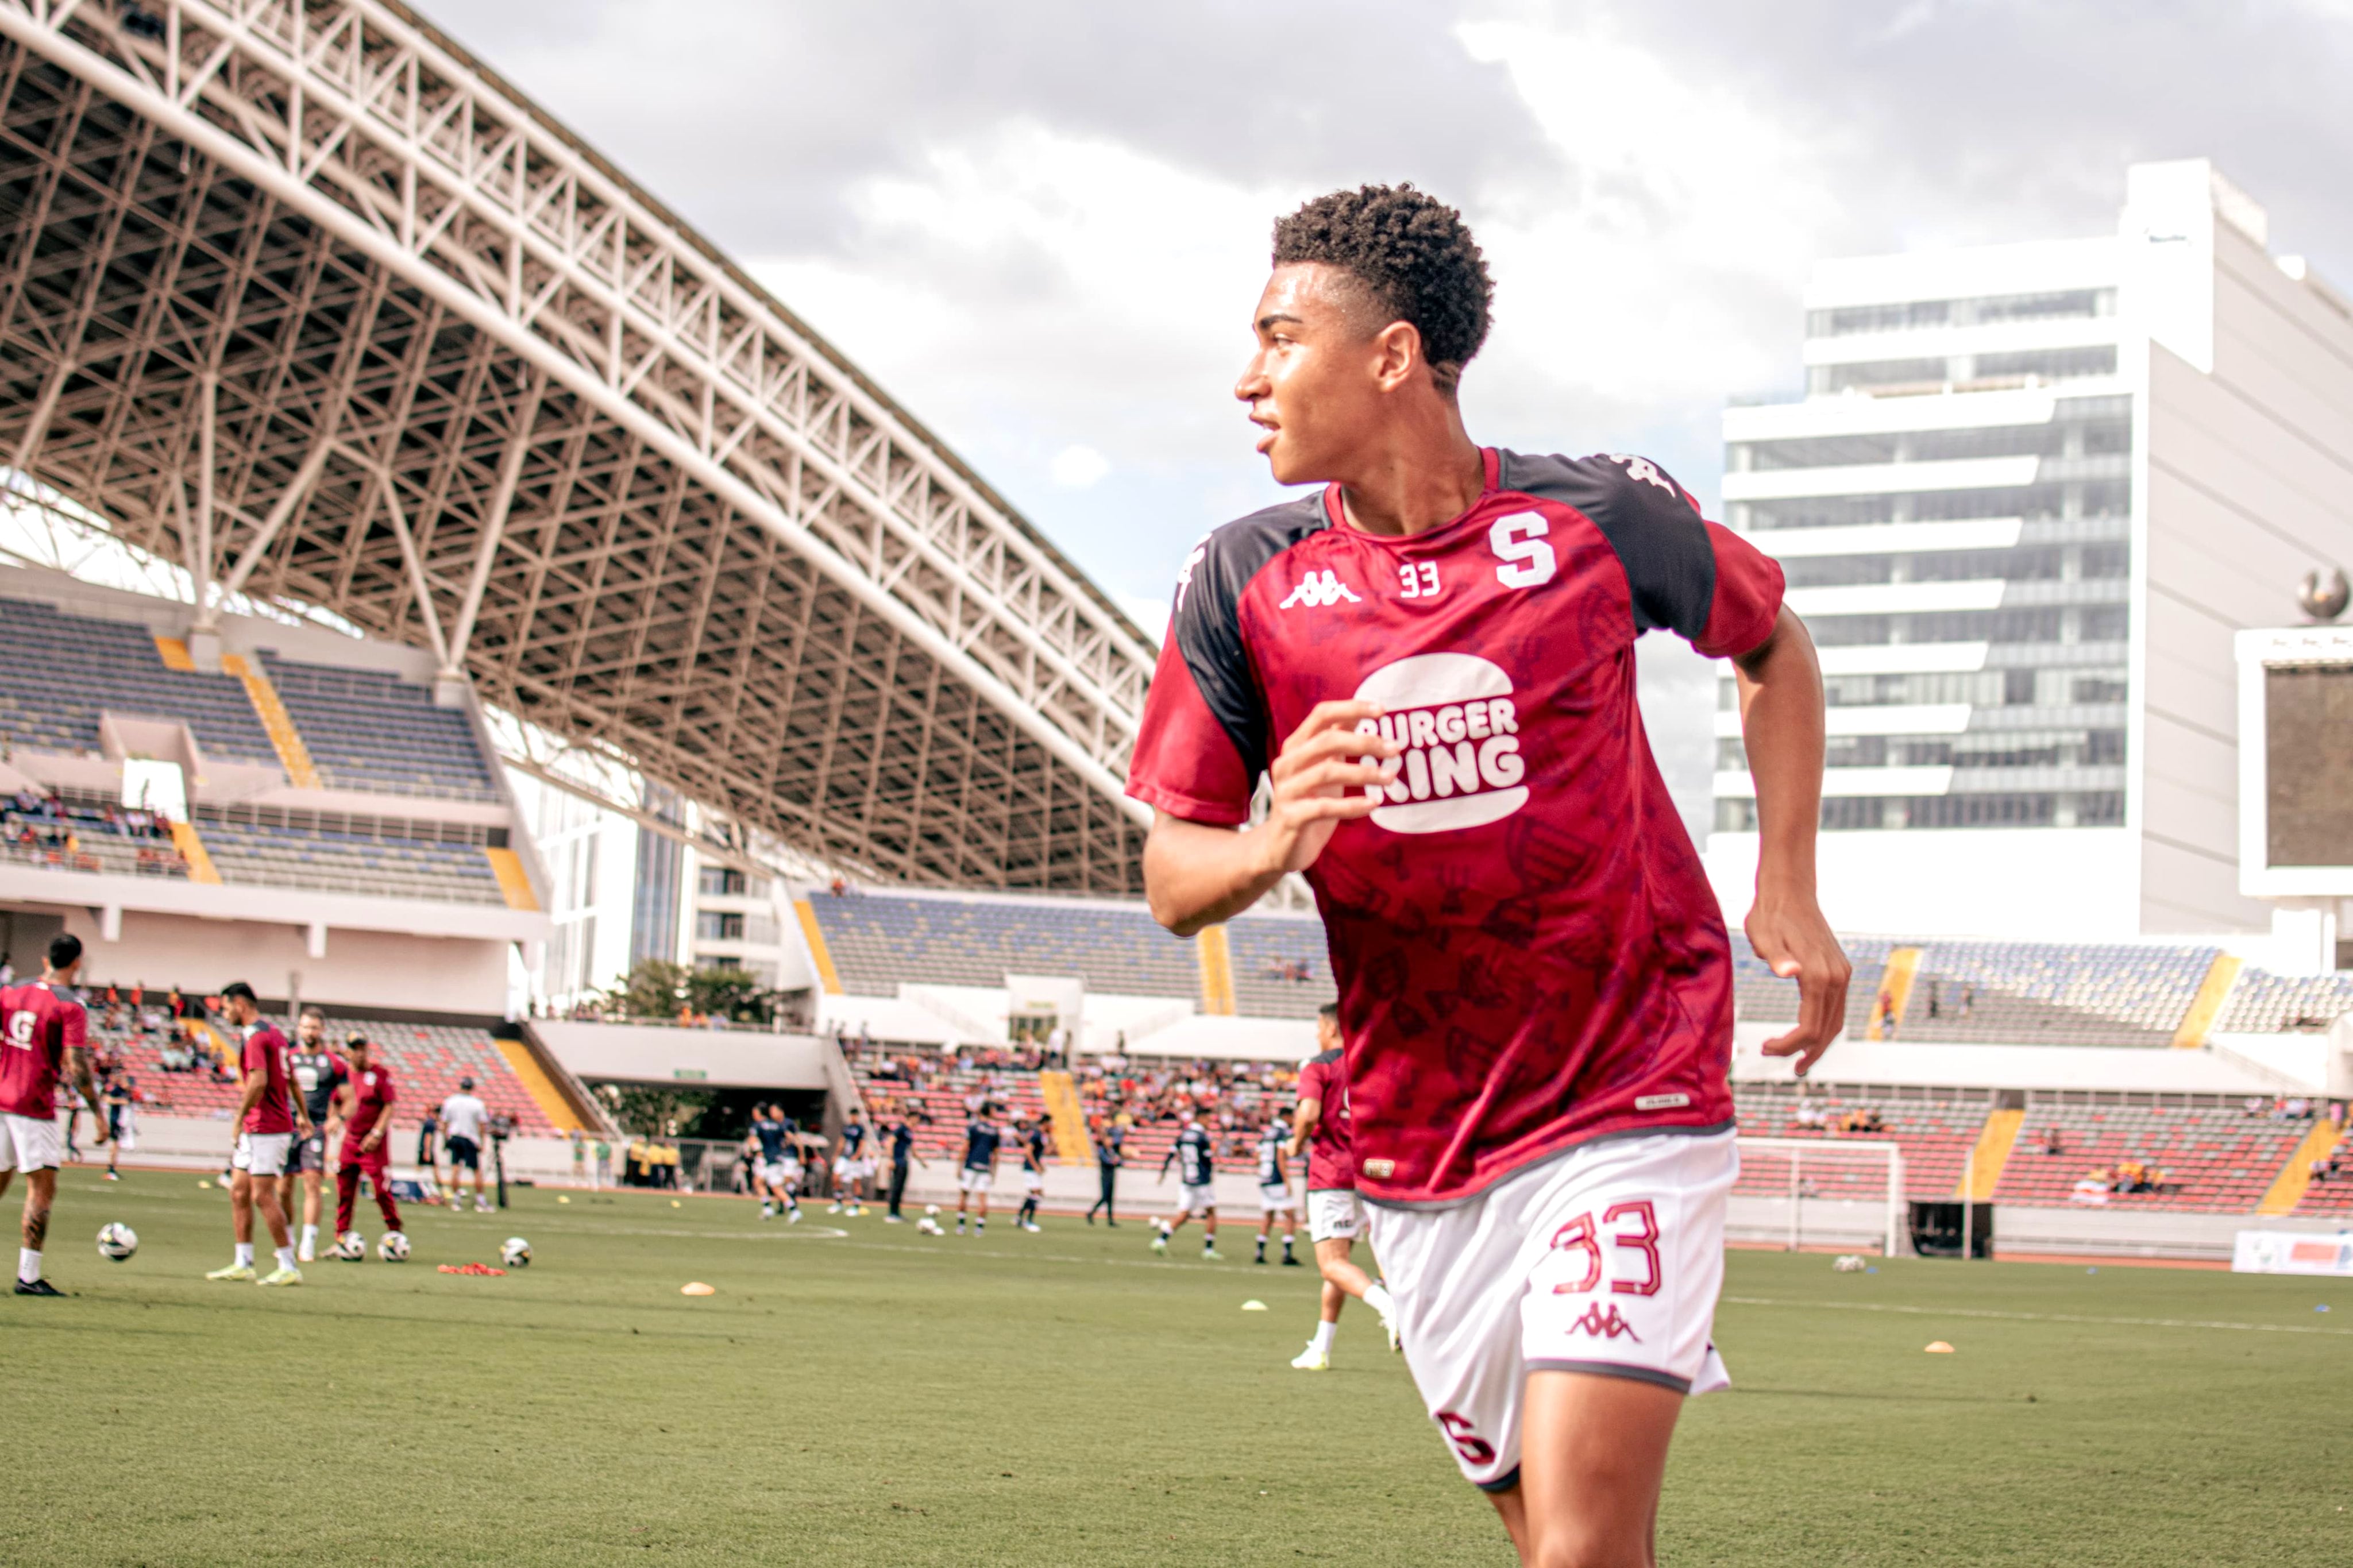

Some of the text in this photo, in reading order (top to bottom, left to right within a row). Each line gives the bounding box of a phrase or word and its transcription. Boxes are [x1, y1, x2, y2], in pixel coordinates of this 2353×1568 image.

[1399, 561, 1441, 598] 33
[1489, 511, 1557, 589] S
[1359, 735, 1526, 805] KING
[1550, 1199, 1661, 1297] 33
